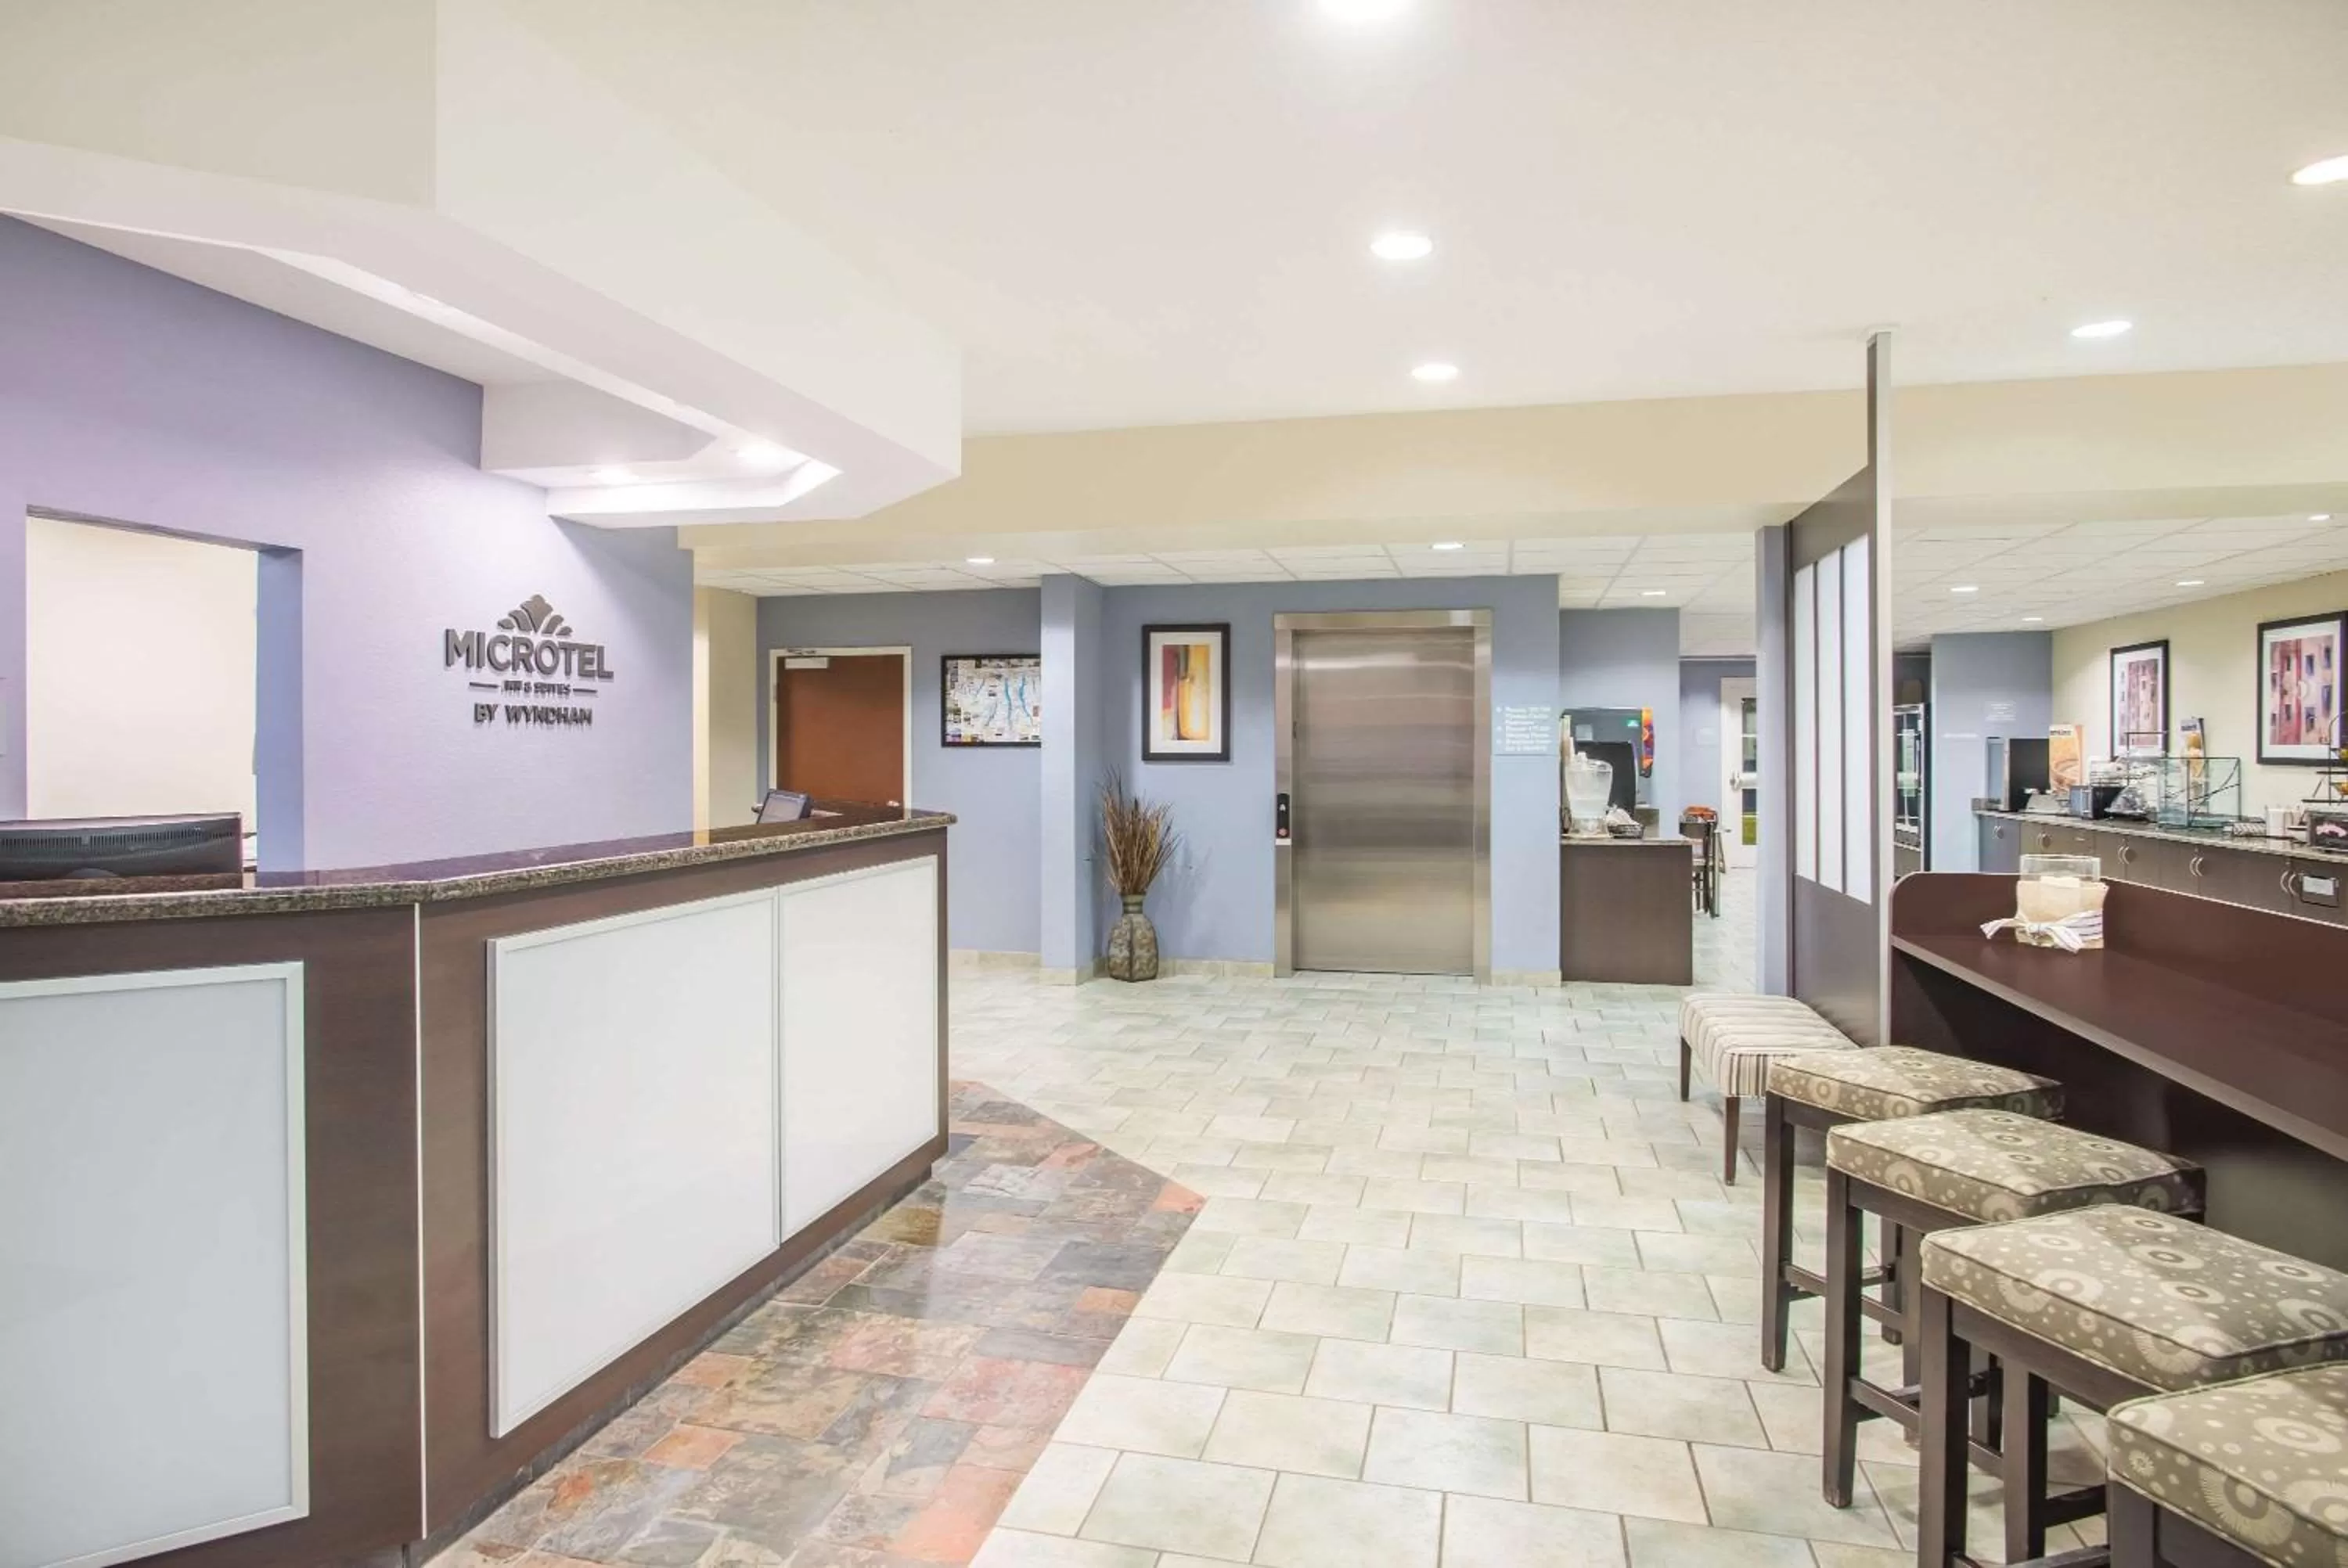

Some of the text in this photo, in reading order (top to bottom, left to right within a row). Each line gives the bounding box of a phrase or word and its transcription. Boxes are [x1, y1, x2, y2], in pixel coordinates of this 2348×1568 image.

[445, 628, 614, 678] MICROTEL
[474, 703, 592, 725] BY WYNDHAM
